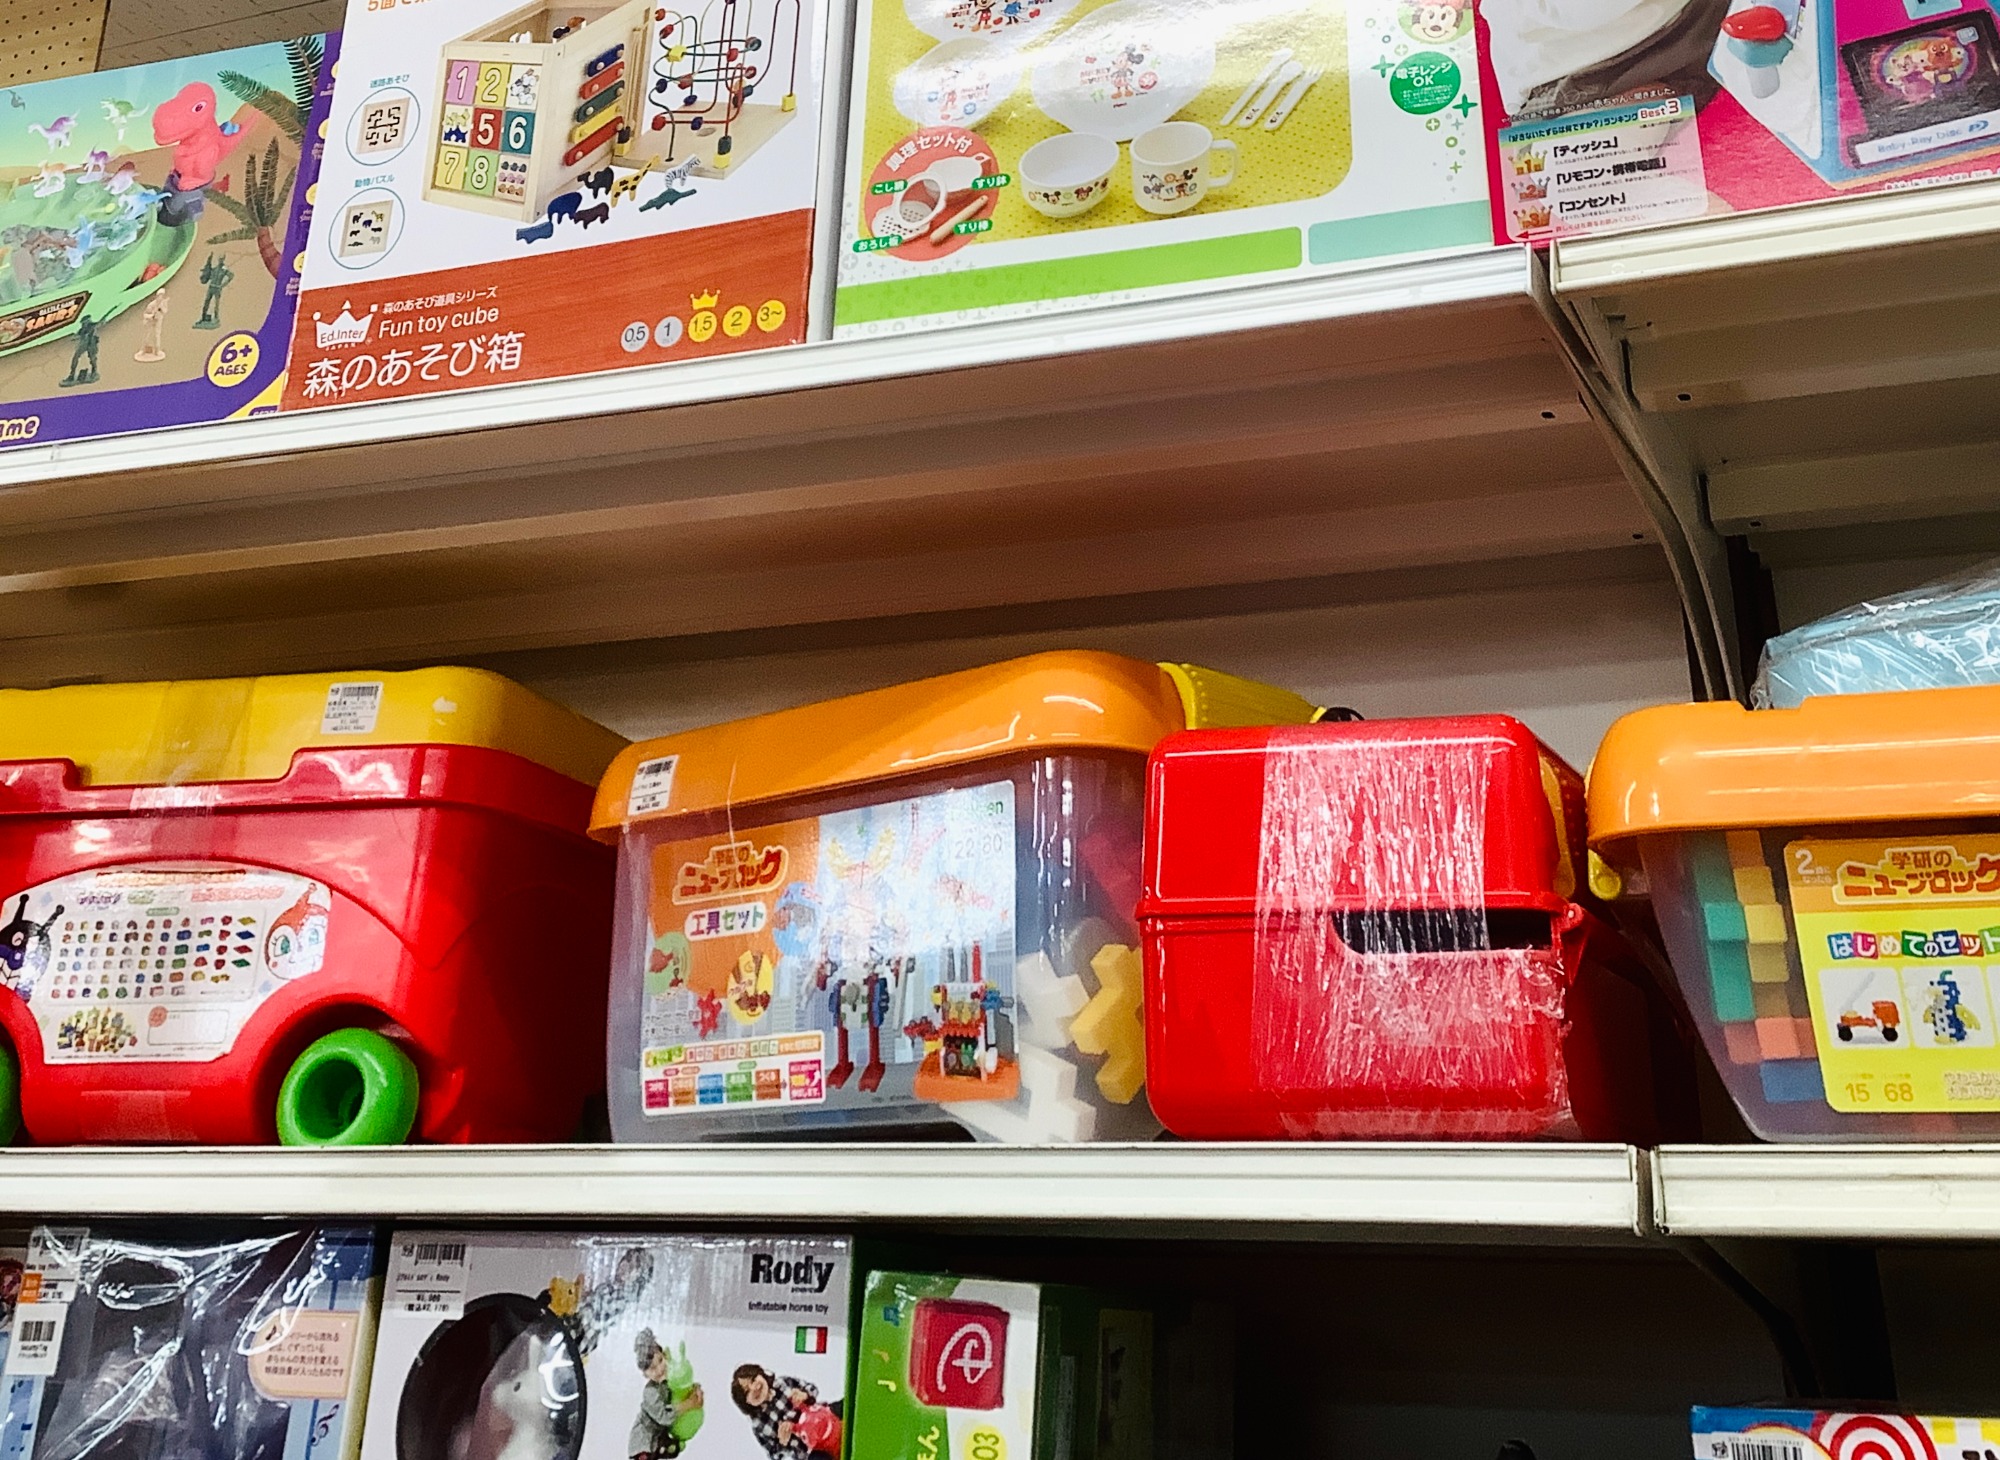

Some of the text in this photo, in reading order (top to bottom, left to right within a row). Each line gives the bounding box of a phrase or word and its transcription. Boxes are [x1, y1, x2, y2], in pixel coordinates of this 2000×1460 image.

[455, 66, 502, 103] 1 2
[1395, 61, 1454, 80] 電子レンジ
[1412, 74, 1435, 87] OK
[1640, 106, 1666, 119] Best
[1667, 99, 1680, 114] 3
[476, 113, 527, 150] 5 6
[444, 151, 490, 190] 7 8
[1559, 191, 1627, 214] 「コンセント」
[382, 285, 499, 315] 森のあそび道具シリーズ
[378, 306, 500, 339] Fun toy cube
[624, 325, 647, 343] 0.5
[663, 322, 671, 337] 1
[691, 314, 713, 332] 1.5
[730, 311, 743, 327] 2
[220, 341, 253, 364] 6+
[302, 330, 526, 399] 森のあそび箱
[213, 363, 248, 377] AGES
[1891, 849, 1952, 870] 学研の
[1843, 856, 2000, 897] ニューブロック
[690, 904, 764, 937] 工具セット
[1832, 930, 2000, 957] はじめてのセット
[1845, 1082, 1914, 1103] 15 68
[749, 1253, 835, 1294] Rody
[748, 1301, 829, 1316] Inflatable horse toy
